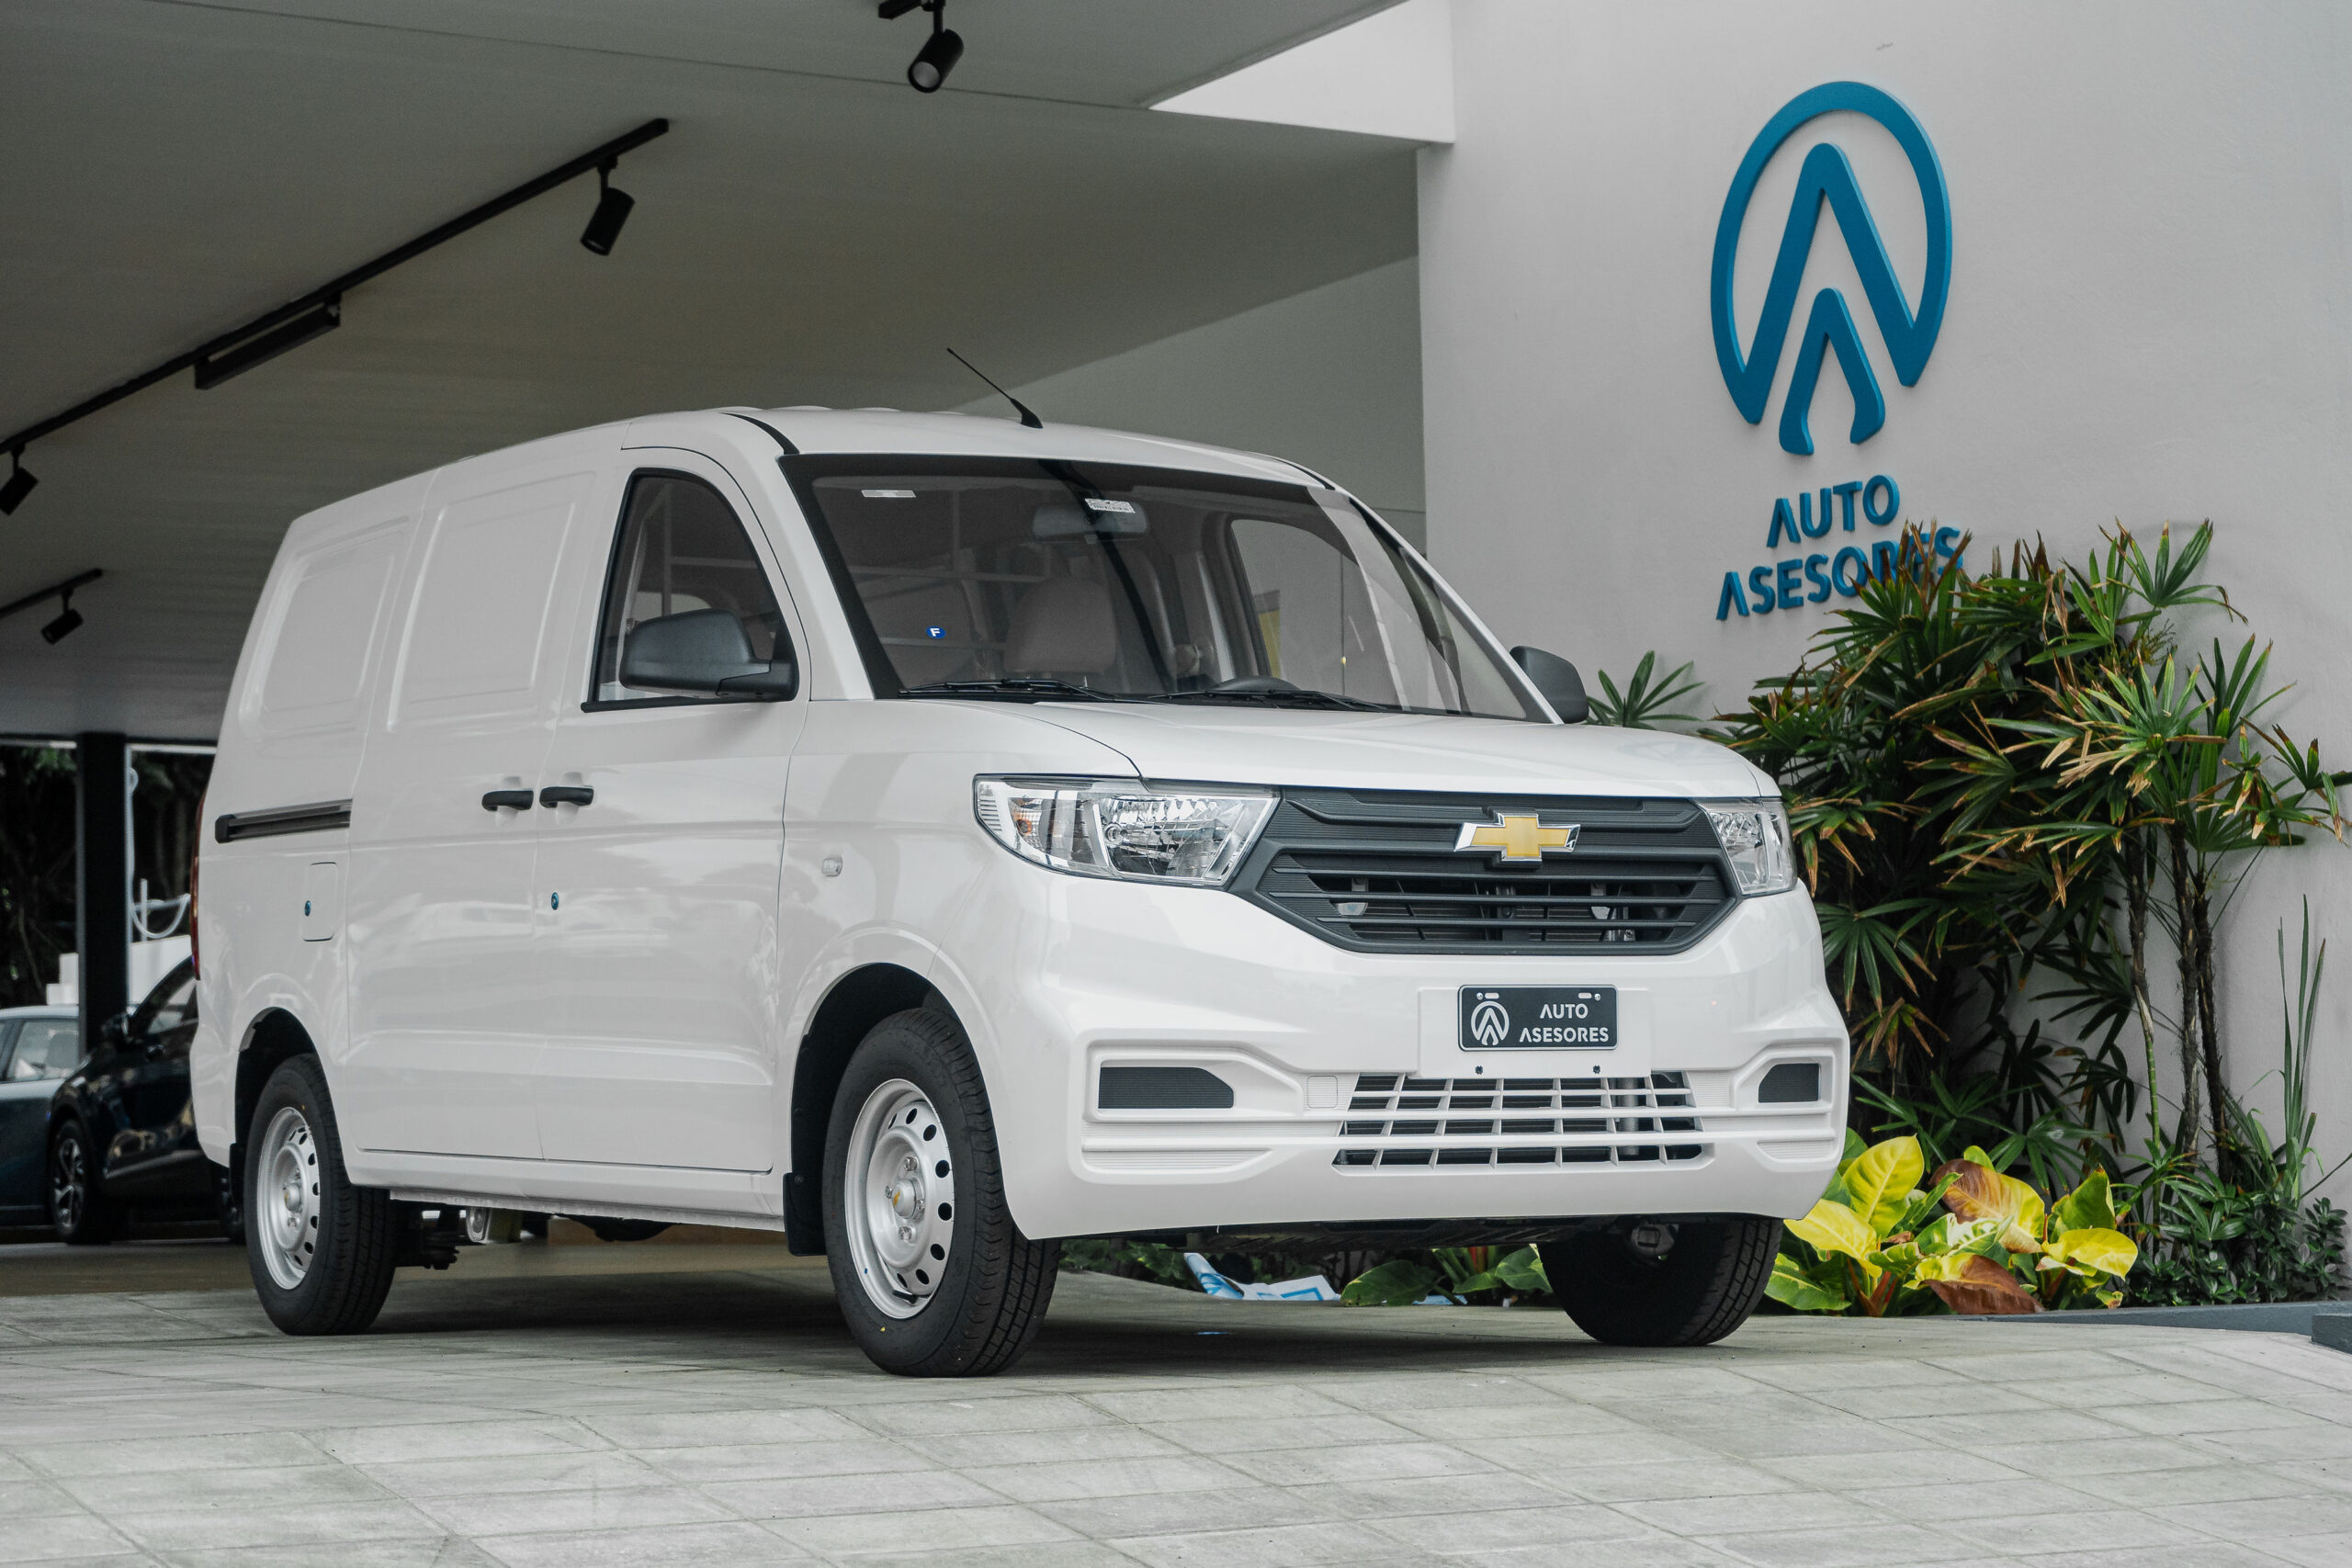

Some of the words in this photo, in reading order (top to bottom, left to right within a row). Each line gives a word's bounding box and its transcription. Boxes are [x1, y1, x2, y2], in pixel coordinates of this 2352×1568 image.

[1766, 474, 1901, 548] AUTO
[1540, 1003, 1589, 1019] AUTO
[1519, 1027, 1609, 1043] ASESORES
